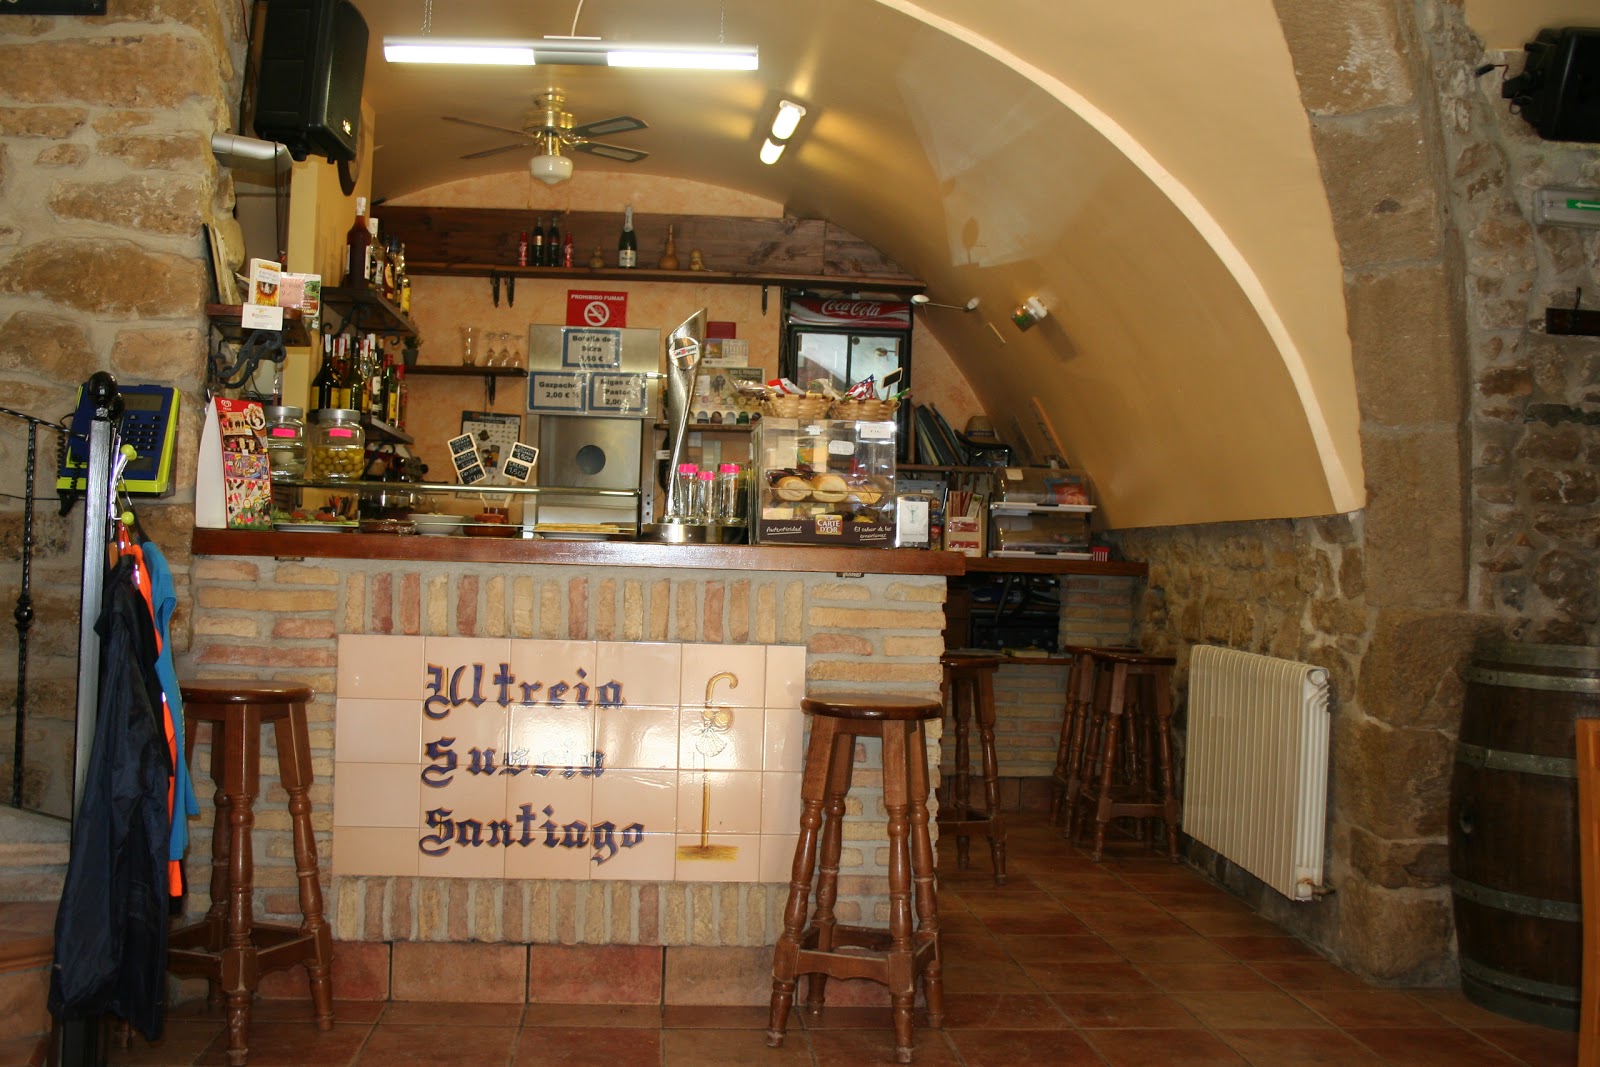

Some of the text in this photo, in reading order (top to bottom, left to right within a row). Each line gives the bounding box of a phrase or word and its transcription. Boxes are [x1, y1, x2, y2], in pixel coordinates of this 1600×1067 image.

[539, 381, 578, 390] Gazpacho
[546, 391, 563, 399] 2,00
[605, 388, 631, 396] Pastor
[605, 398, 622, 406] 2,00
[817, 519, 841, 528] CARTE
[418, 803, 645, 866] Santiago
